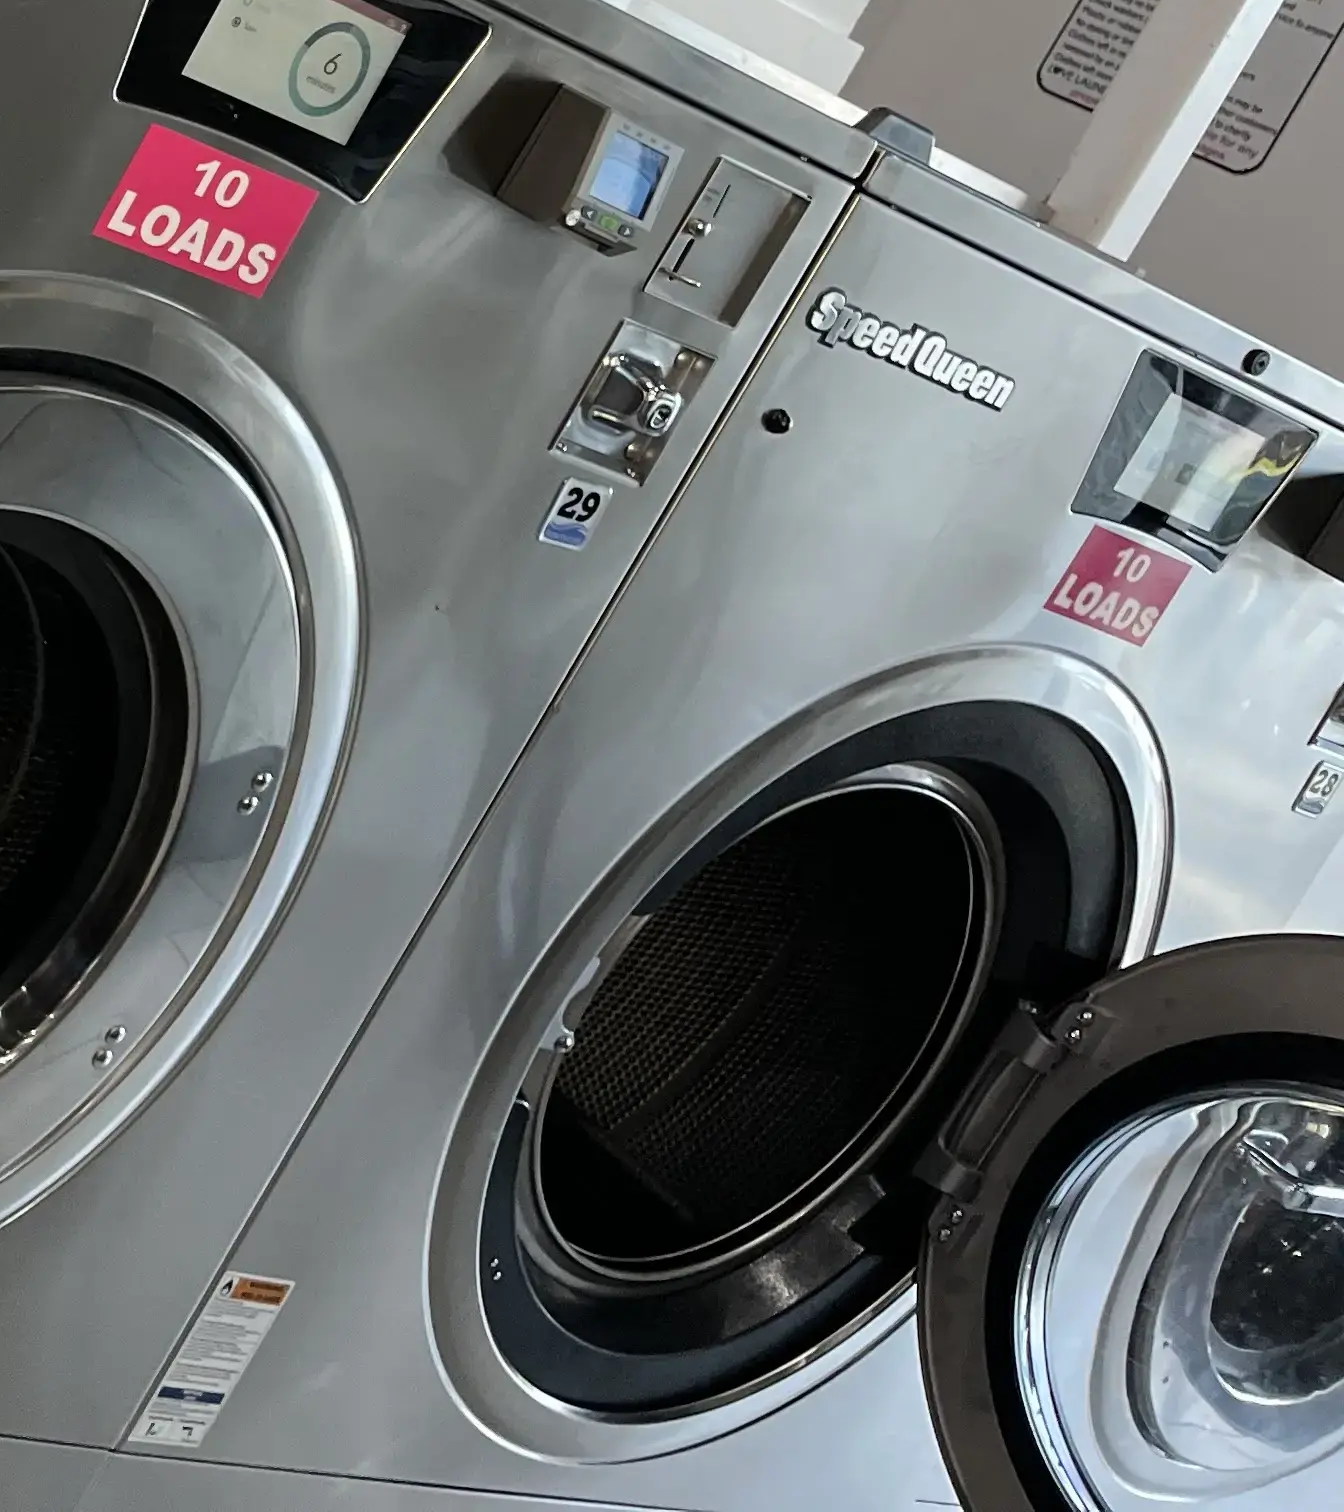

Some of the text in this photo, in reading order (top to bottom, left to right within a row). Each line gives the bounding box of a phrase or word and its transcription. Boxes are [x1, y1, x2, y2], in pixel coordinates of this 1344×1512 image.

[323, 52, 342, 75] 6
[195, 159, 250, 208] 10
[107, 190, 276, 286] LOADS
[557, 487, 600, 522] 29
[1113, 547, 1151, 582] 10
[1053, 574, 1160, 639] LOADS
[1309, 770, 1339, 797] 28
